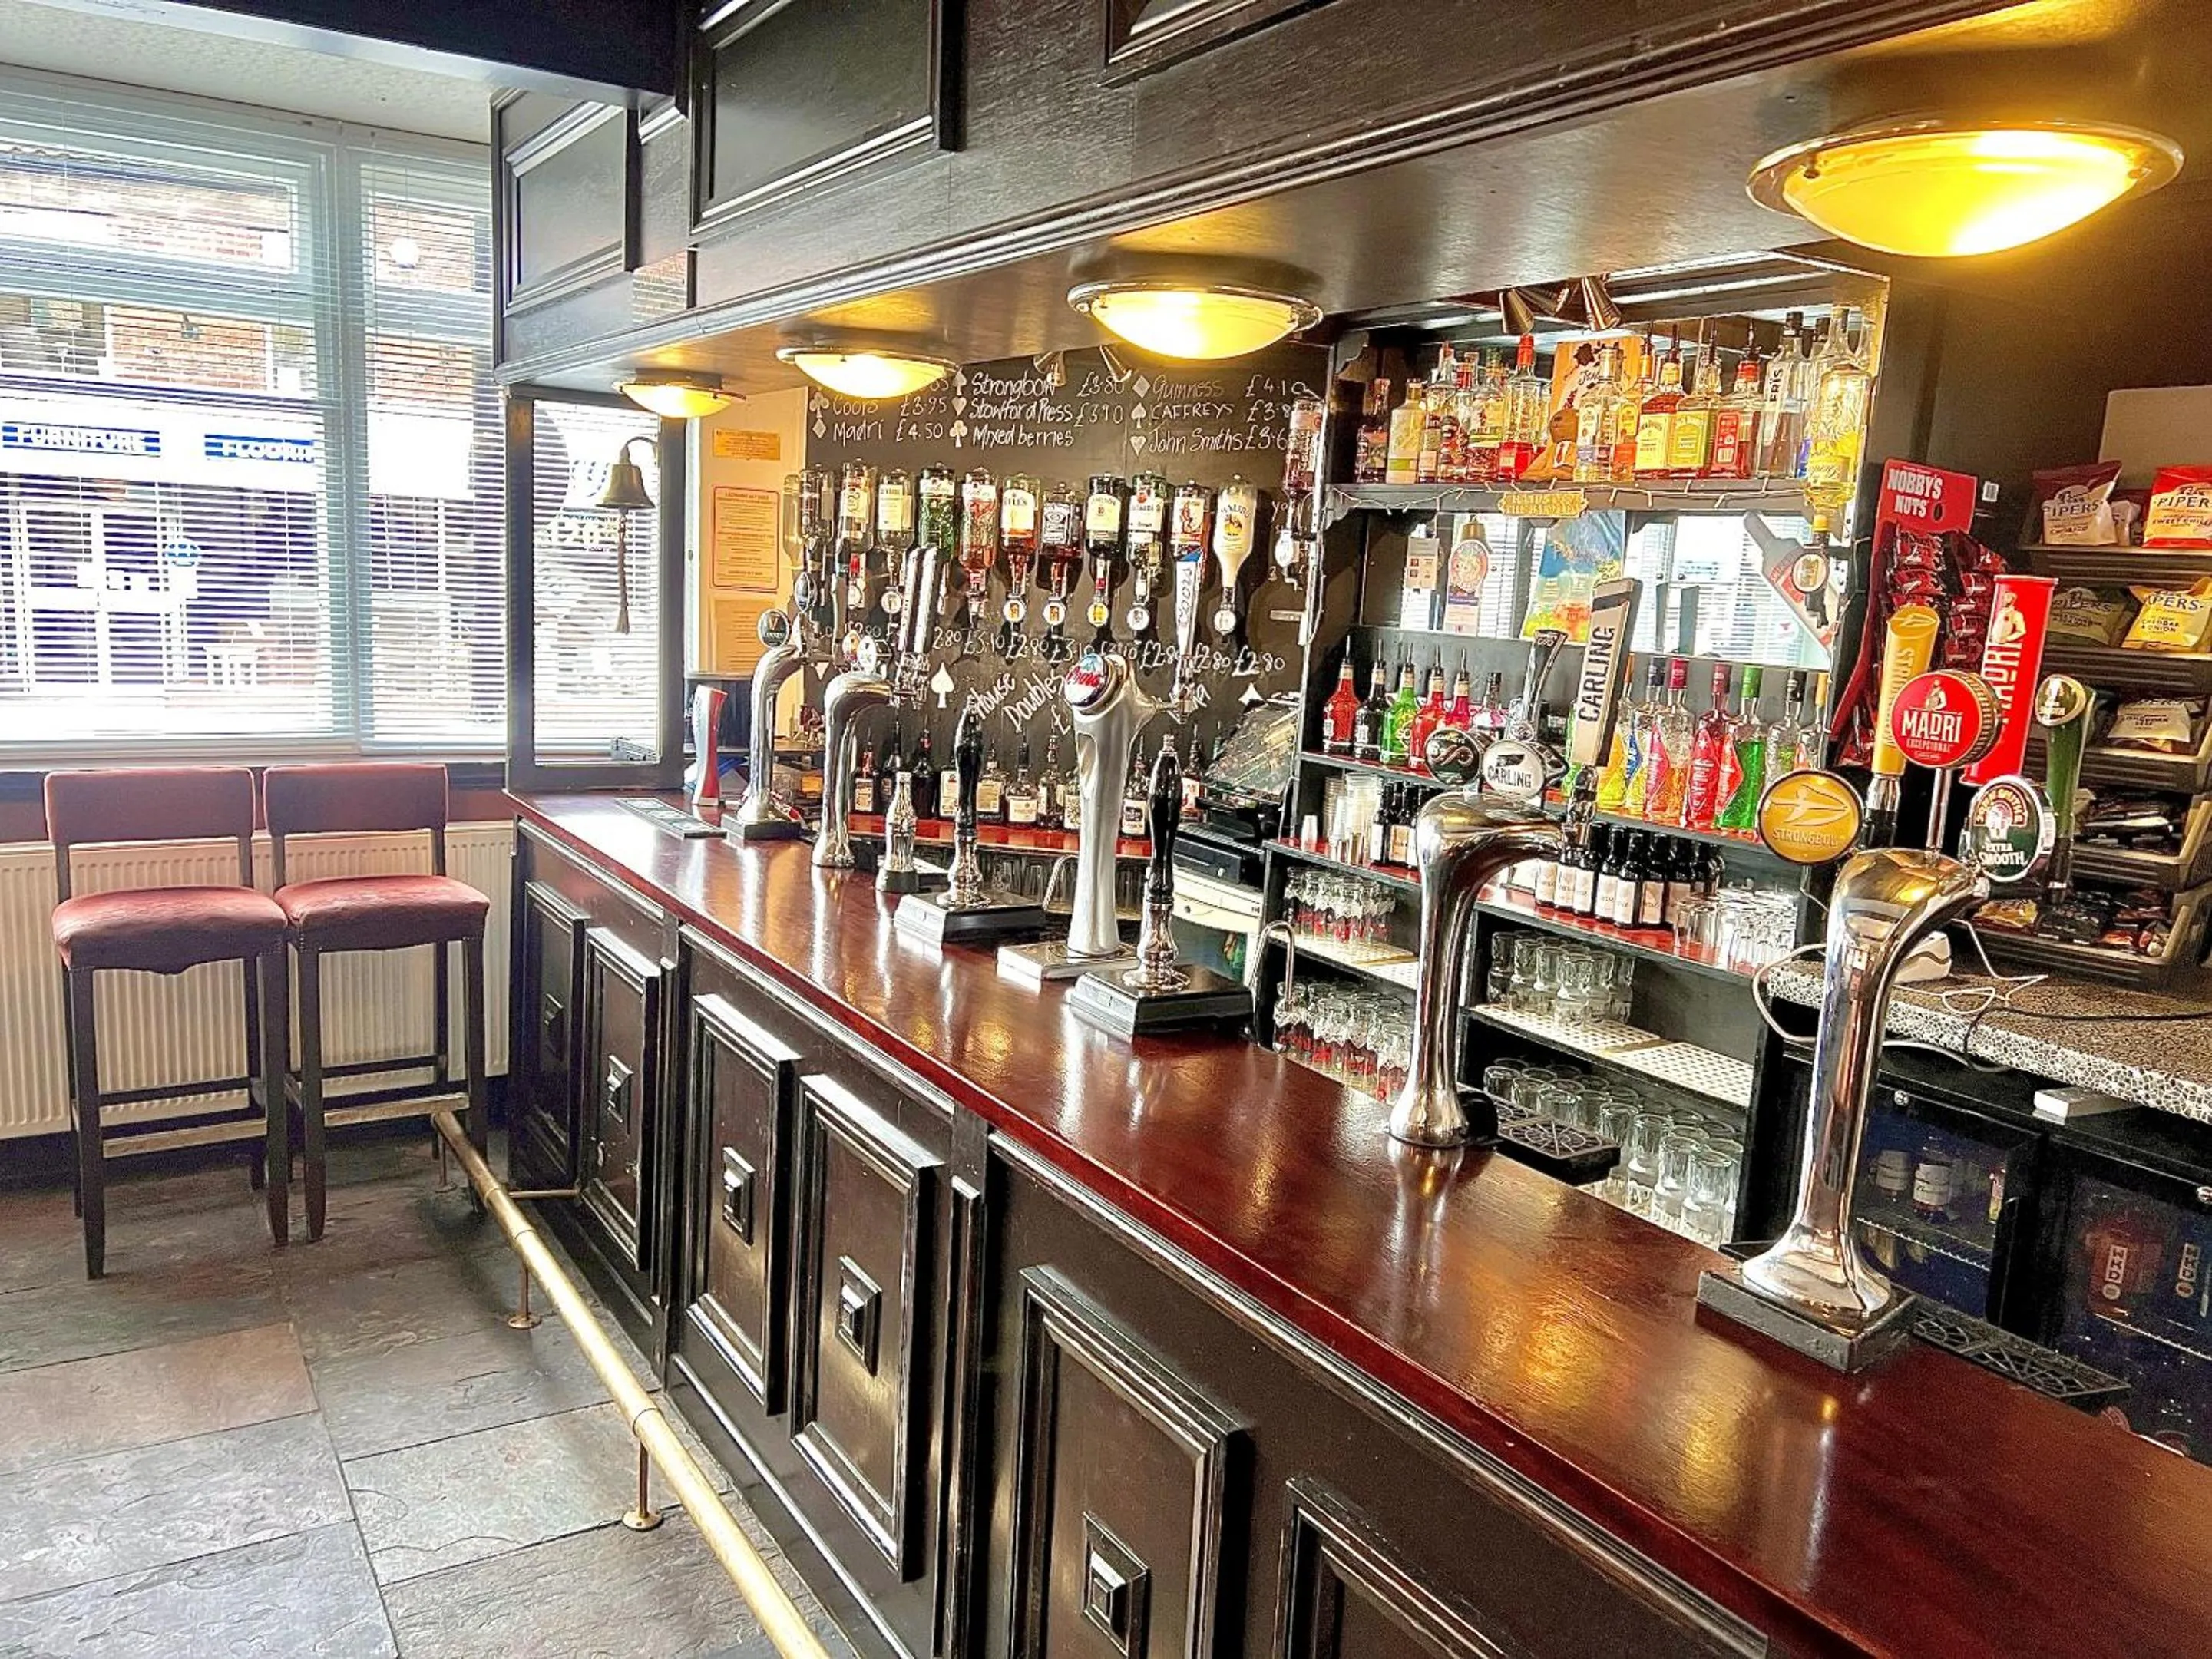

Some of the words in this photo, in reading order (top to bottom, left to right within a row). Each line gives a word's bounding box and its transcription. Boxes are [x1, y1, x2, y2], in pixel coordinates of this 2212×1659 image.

[832, 396, 879, 415] Coors
[1246, 398, 1293, 423] £3.8
[1149, 422, 1187, 454] John
[1244, 423, 1288, 451] £3.6
[1886, 468, 1943, 500] NOBBY'S
[1894, 495, 1927, 518] NUTS
[2157, 497, 2212, 508] PIPER
[1579, 626, 1616, 722] CARLING
[1486, 765, 1532, 788] CARLING
